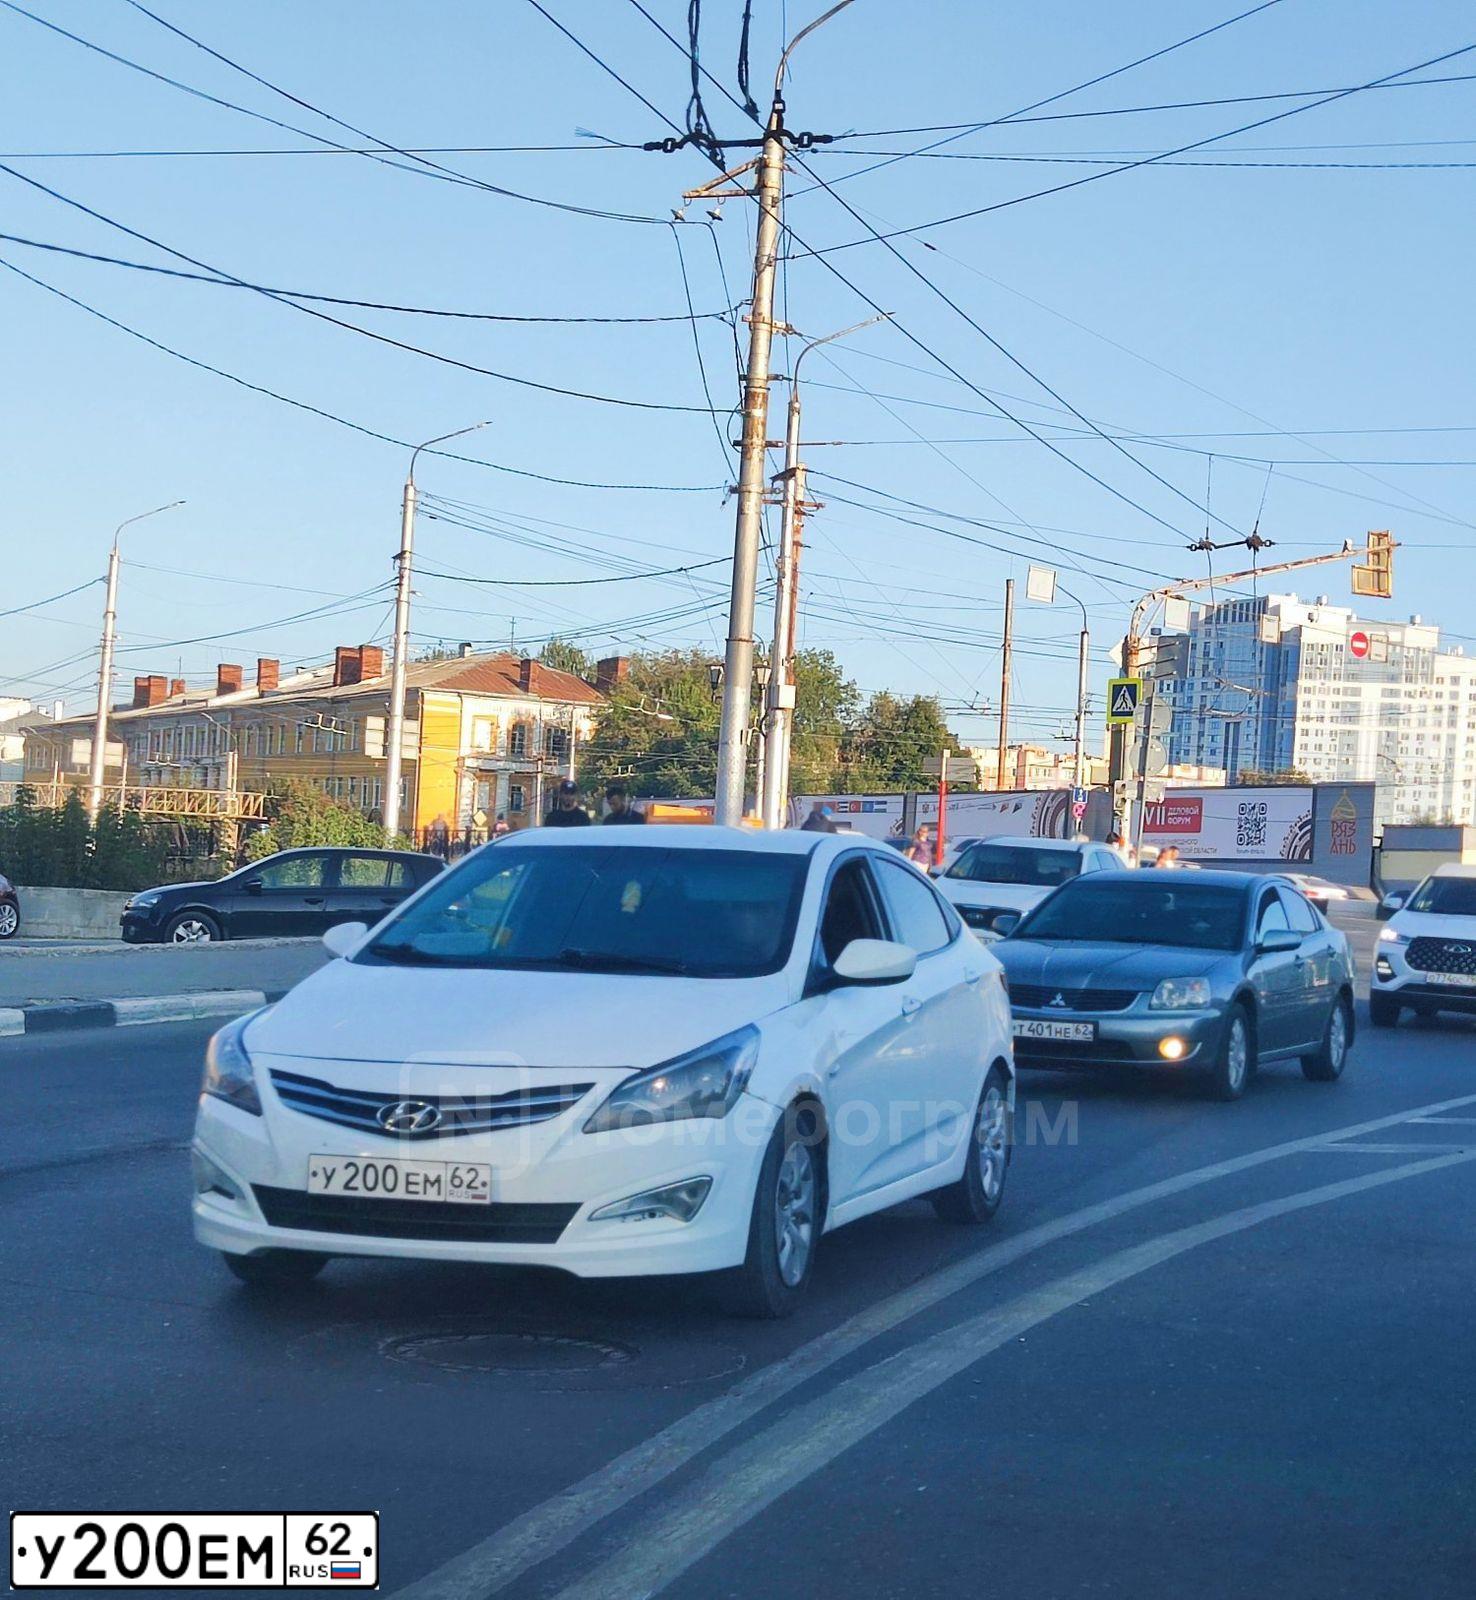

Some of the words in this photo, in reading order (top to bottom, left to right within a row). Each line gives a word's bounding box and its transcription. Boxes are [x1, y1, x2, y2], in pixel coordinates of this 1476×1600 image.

[1167, 806, 1200, 816] ДЕЛОВОЙ
[1167, 816, 1192, 825] ФОРУМ
[450, 1166, 480, 1190] 62
[449, 1189, 471, 1199] RUS
